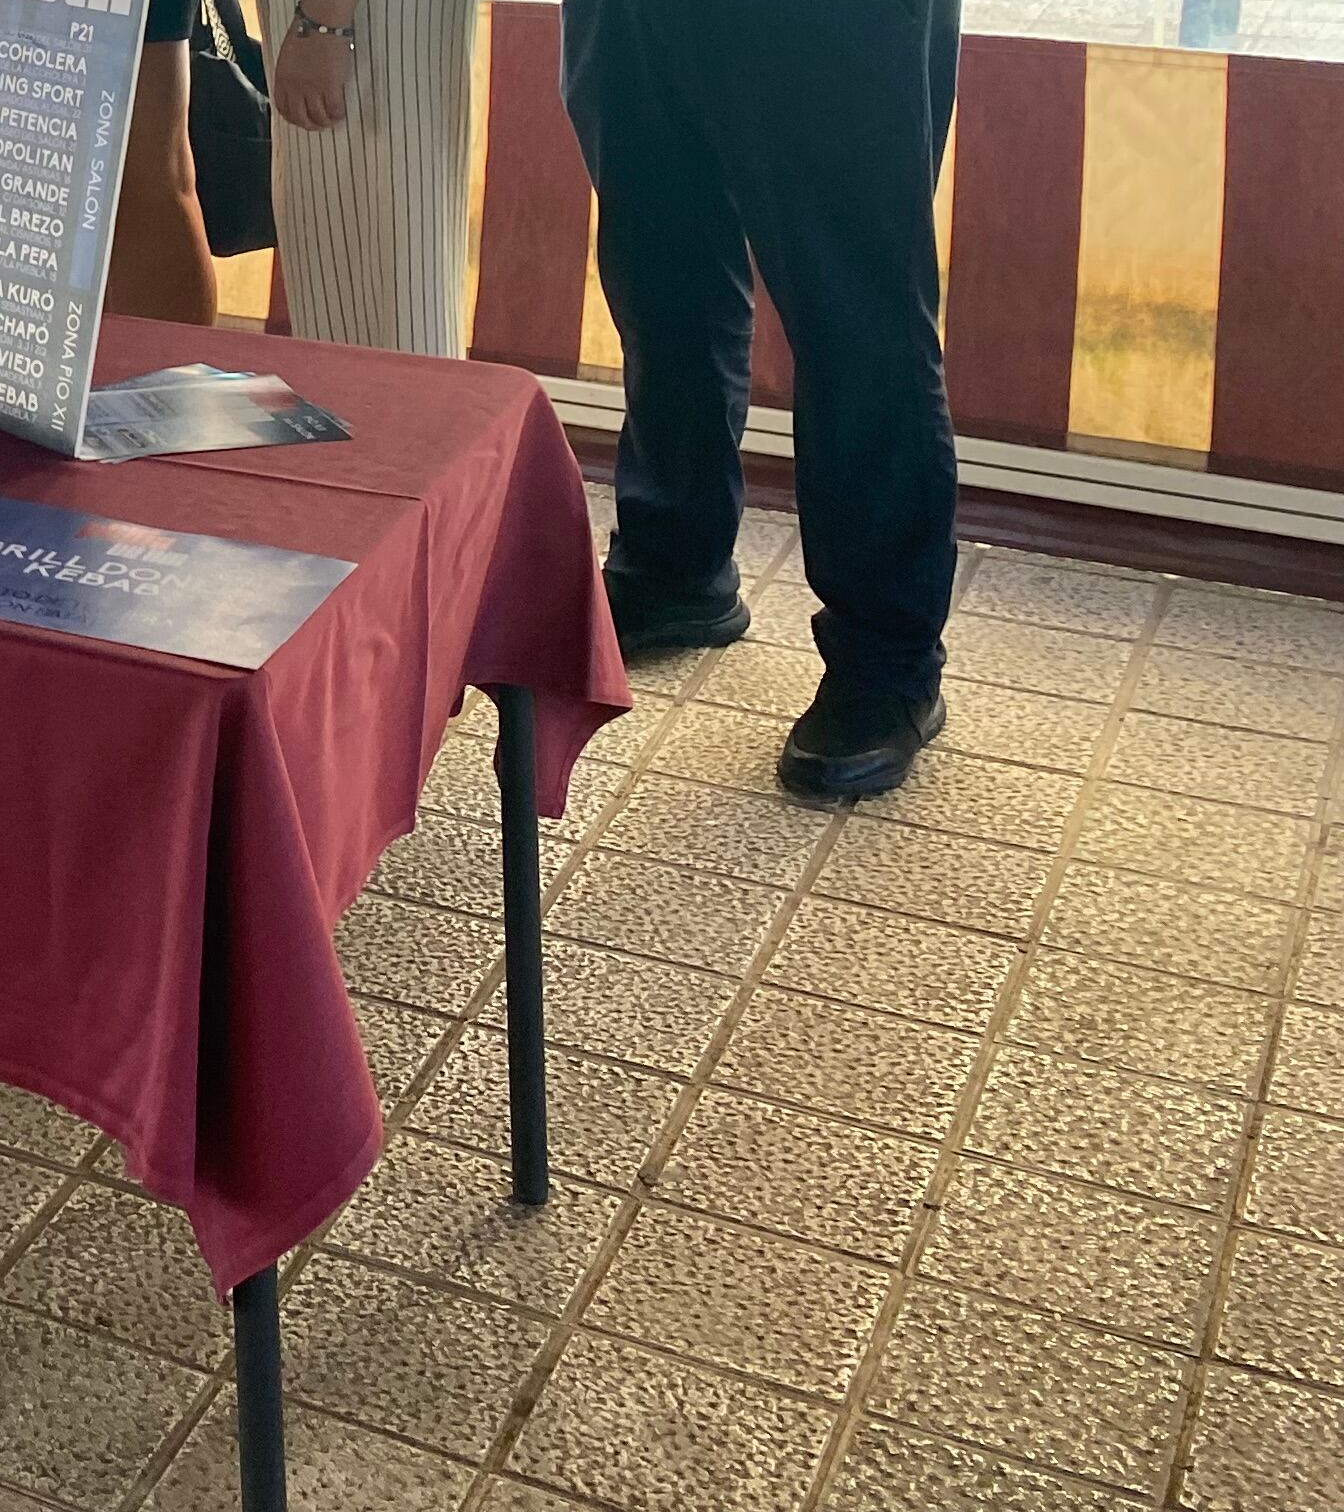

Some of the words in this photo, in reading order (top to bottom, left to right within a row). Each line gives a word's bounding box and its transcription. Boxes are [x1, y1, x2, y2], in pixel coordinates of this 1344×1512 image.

[69, 21, 94, 43] P21
[31, 80, 84, 108] SPORT
[94, 89, 115, 150] ZONA
[0, 172, 69, 207] GRANDE
[10, 207, 64, 239] BREZO
[20, 243, 59, 271] PEPA
[6, 277, 55, 313] KURÓ
[61, 301, 82, 362] ZONA
[55, 364, 75, 402] PÍO
[50, 402, 66, 431] XII
[23, 562, 160, 596] KEBAB
[98, 561, 197, 589] DON
